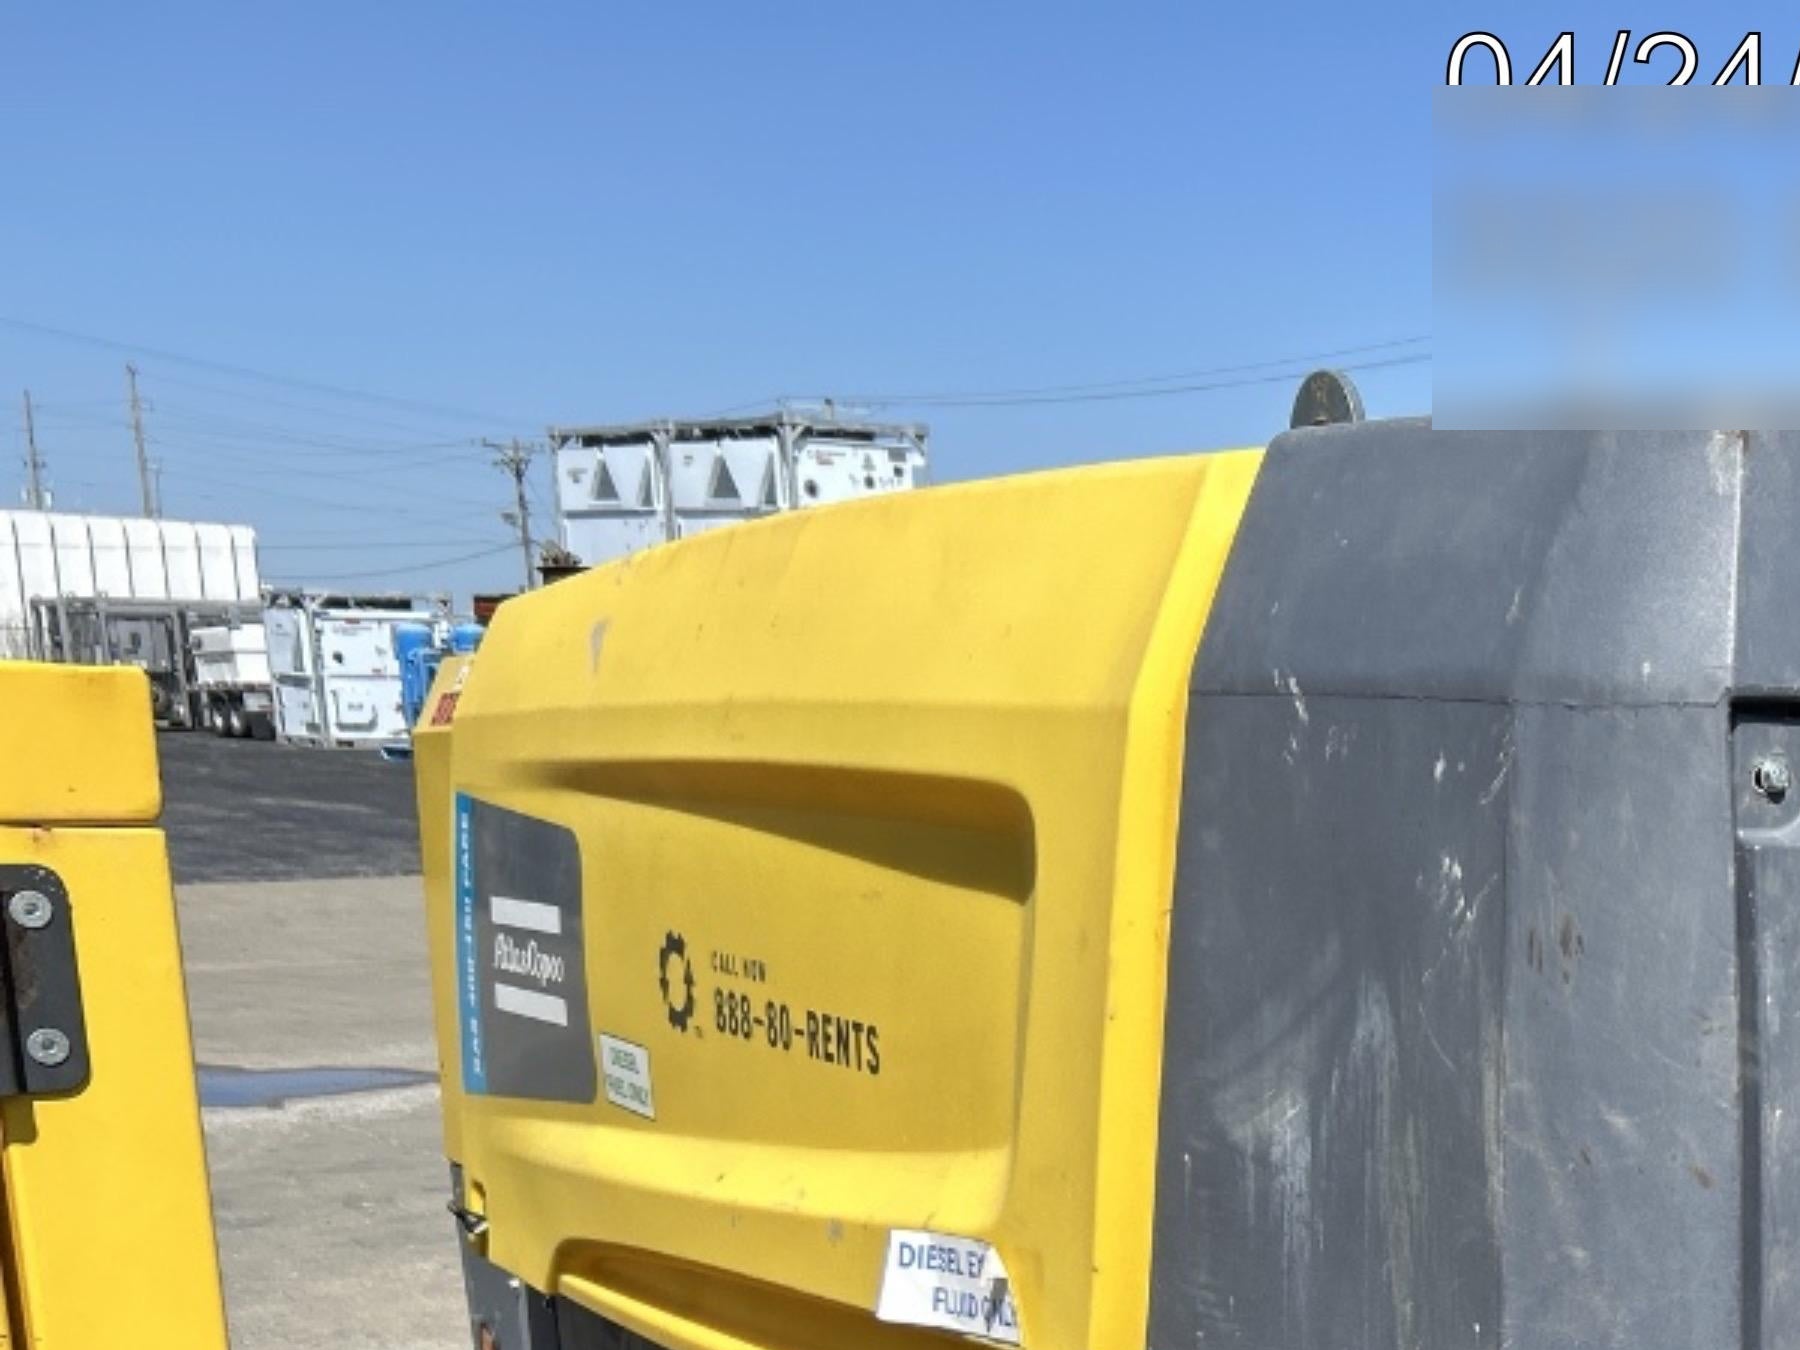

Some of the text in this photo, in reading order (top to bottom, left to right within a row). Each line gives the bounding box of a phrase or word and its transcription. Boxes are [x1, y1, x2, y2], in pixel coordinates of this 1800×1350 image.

[714, 986, 880, 1075] 888-80-RENTS
[899, 1241, 964, 1276] DIESEL
[932, 1286, 978, 1318] FLUID
